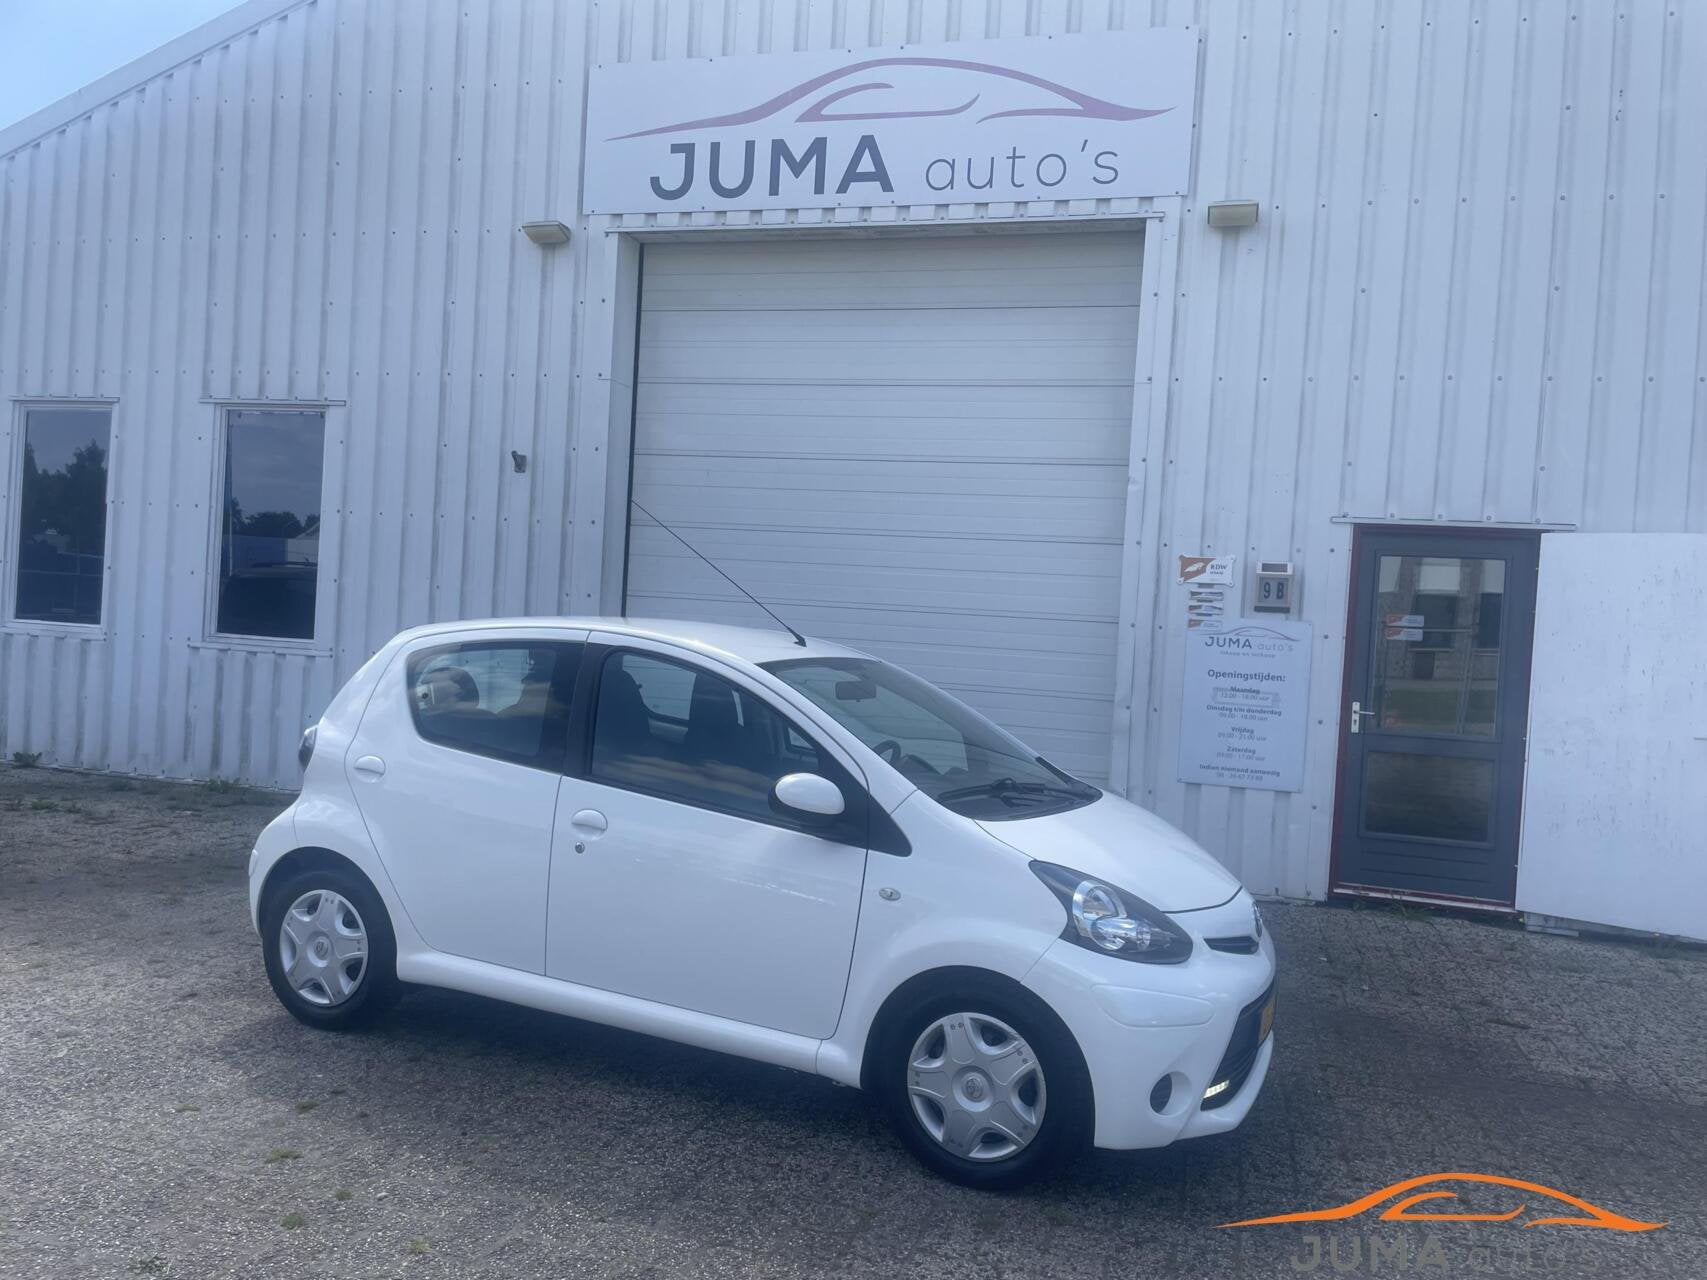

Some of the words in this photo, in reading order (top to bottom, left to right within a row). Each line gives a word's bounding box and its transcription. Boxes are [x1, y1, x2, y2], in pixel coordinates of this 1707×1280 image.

[649, 133, 895, 201] JUMA
[925, 138, 1120, 192] auto's
[1205, 636, 1252, 649] JUMA
[1257, 642, 1294, 652] auto's
[1207, 669, 1286, 682] Openingstijden:
[1246, 707, 1282, 716] donderdag
[1231, 726, 1254, 734] Vrijdag
[1226, 746, 1256, 754] Zaterdag
